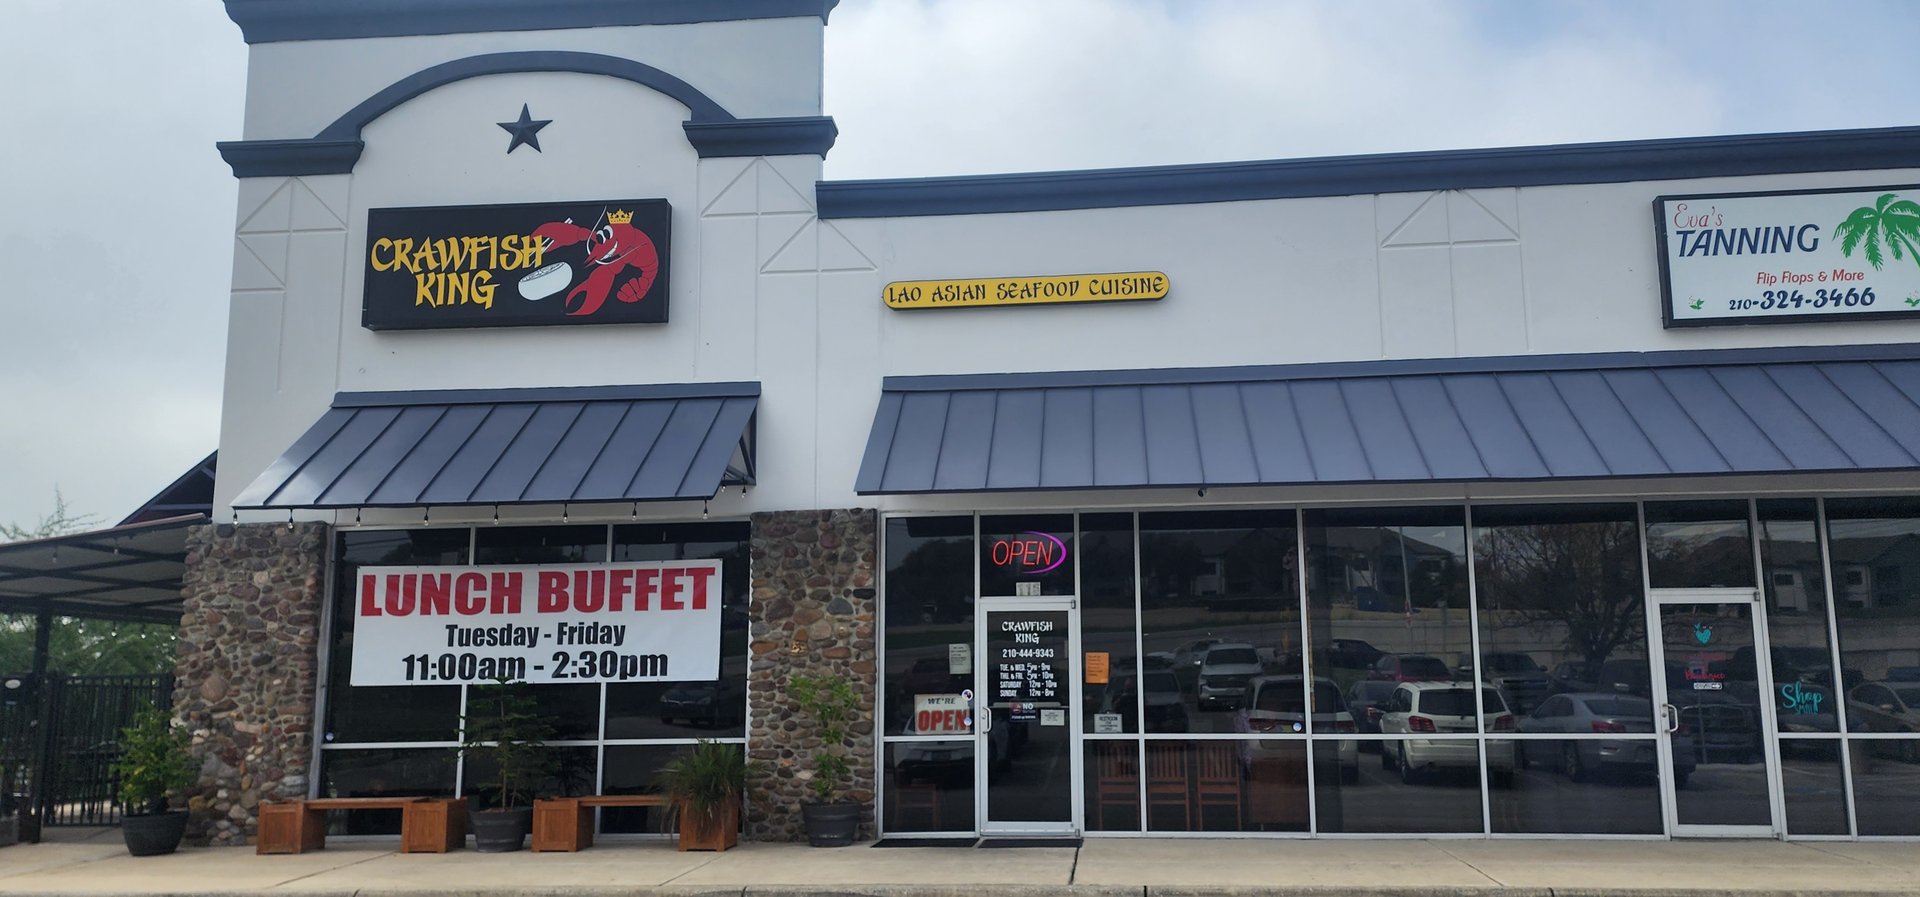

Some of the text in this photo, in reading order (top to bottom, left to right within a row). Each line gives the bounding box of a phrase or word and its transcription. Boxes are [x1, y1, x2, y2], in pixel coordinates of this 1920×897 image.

[1674, 203, 1723, 228] Eva's
[1676, 223, 1820, 257] TANNING
[370, 233, 546, 274] CRAWFISH
[415, 270, 500, 310] KING
[889, 276, 1164, 303] LAO ASIAN SEAFOOD CUISINE
[1756, 269, 1865, 285] Flip Flops & More
[1729, 287, 1876, 310] 210-324-3466
[992, 540, 1053, 566] OPEN
[360, 567, 716, 616] LUNCH BUFFET
[445, 623, 539, 648] Tuesday
[557, 622, 626, 646] Friday
[1001, 621, 1053, 632] CRAWFISH
[1015, 633, 1039, 644] KING
[402, 653, 526, 681] 11:00am
[551, 650, 668, 680] 2:30pm
[1002, 648, 1054, 658] 210-444-9343
[1782, 682, 1823, 711] Shop
[918, 709, 967, 731] OPEN
